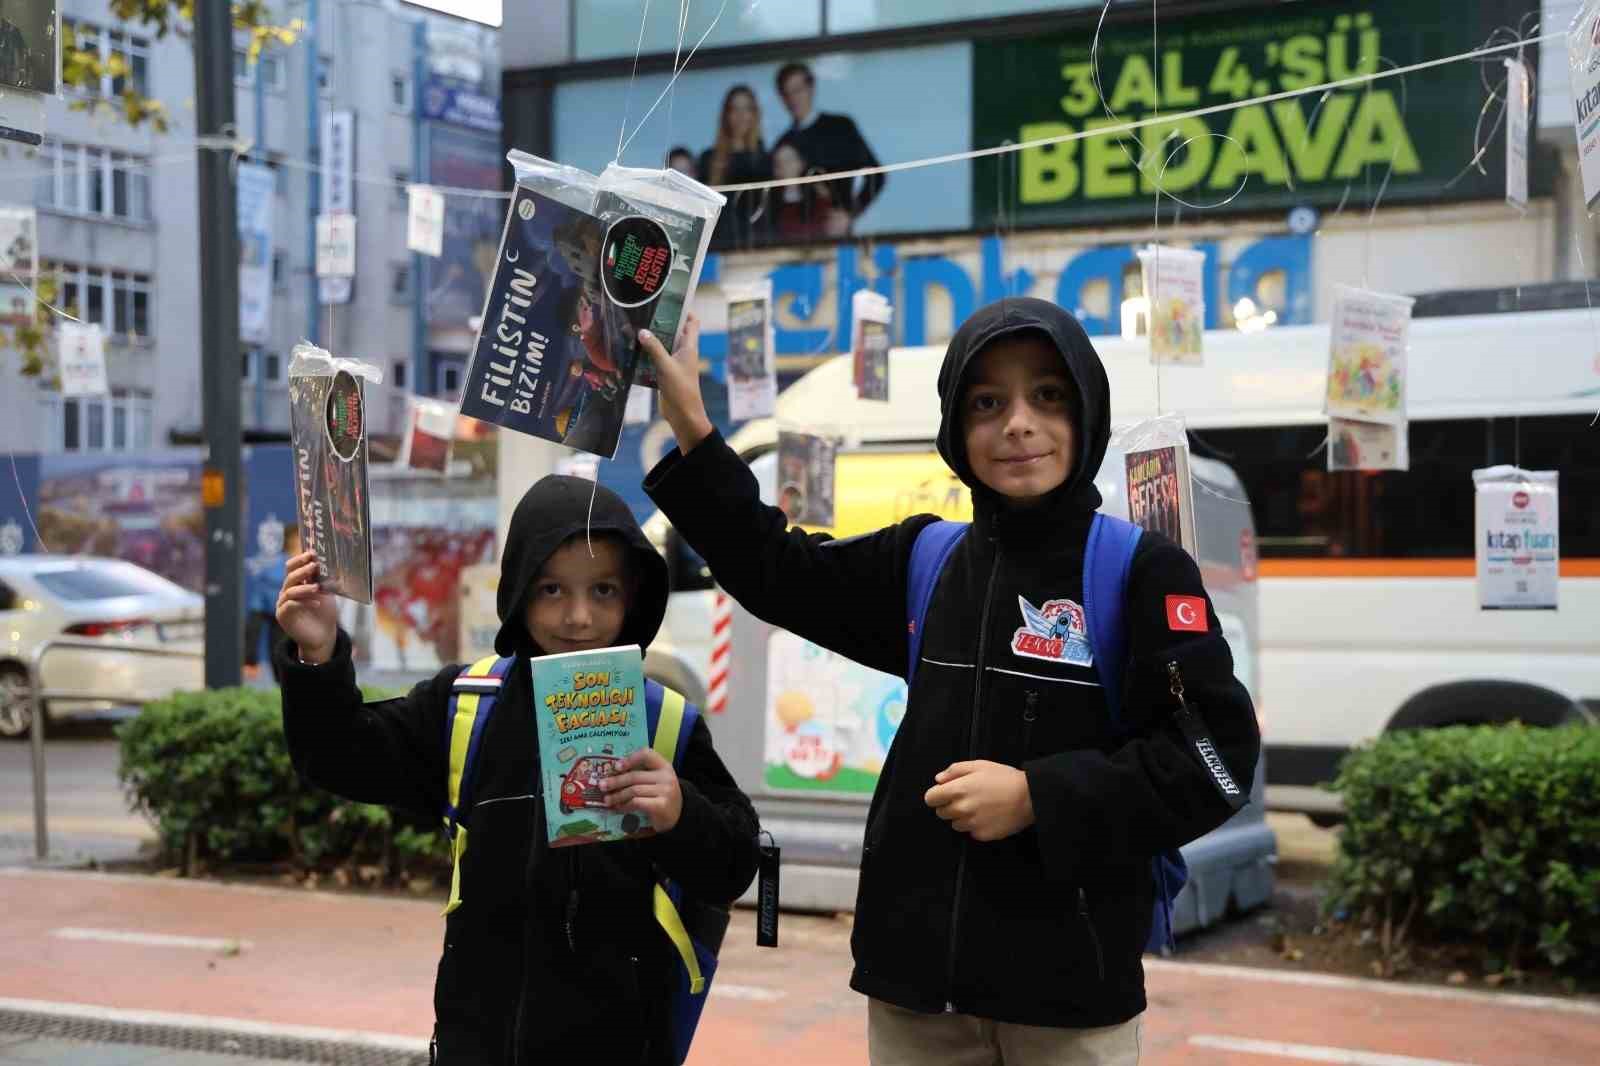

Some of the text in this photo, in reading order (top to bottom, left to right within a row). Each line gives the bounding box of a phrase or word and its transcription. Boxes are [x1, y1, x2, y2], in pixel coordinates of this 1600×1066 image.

[1060, 62, 1098, 117] 3
[1108, 50, 1199, 112] AL
[1019, 89, 1421, 206] BEDAVA
[574, 671, 611, 691] SON
[1195, 736, 1241, 796] TEKNOFEST
